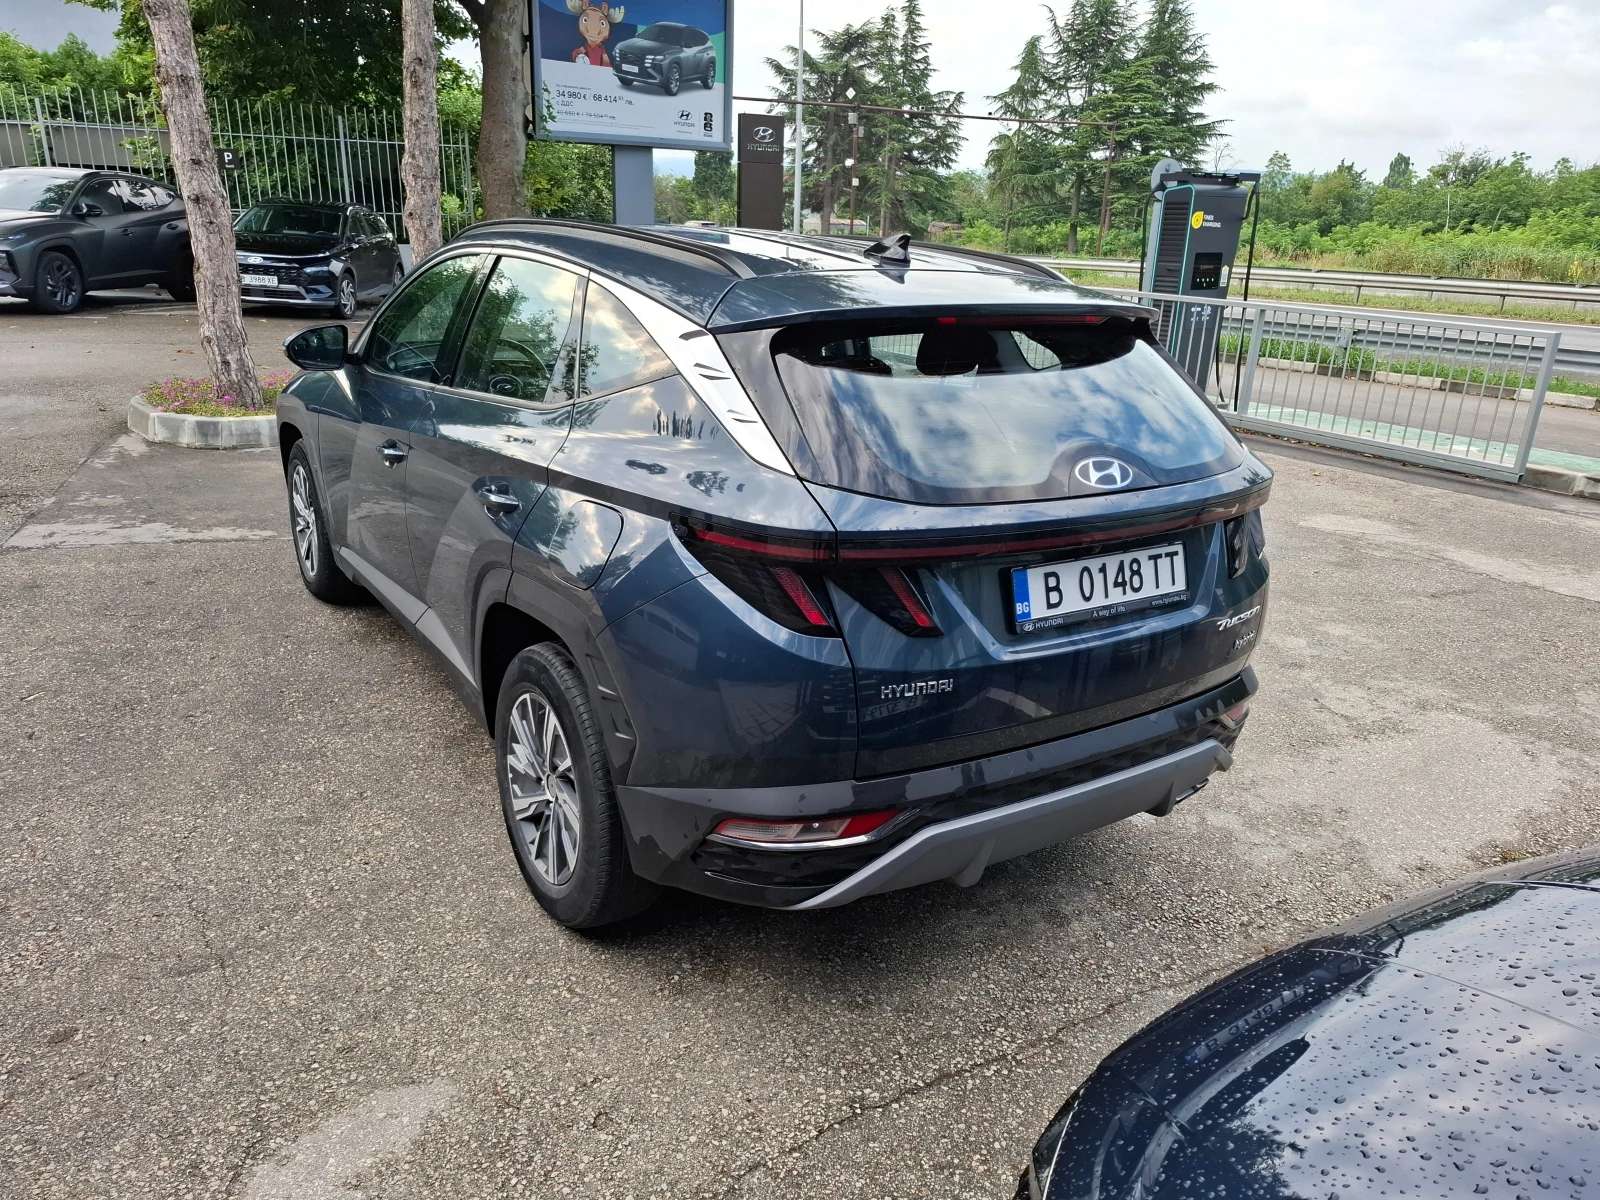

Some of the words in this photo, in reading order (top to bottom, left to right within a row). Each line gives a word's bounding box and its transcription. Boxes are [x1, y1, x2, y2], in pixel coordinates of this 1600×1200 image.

[224, 152, 232, 163] P
[747, 143, 780, 152] HYUNDAI
[1043, 570, 1064, 611] B
[1078, 557, 1144, 602] 0148
[1148, 551, 1180, 590] TT
[1016, 602, 1030, 615] BG
[1217, 605, 1261, 631] TUCSON
[1035, 618, 1064, 629] HYUNDAI
[1098, 609, 1109, 617] way
[881, 679, 954, 699] HYUNDAI
